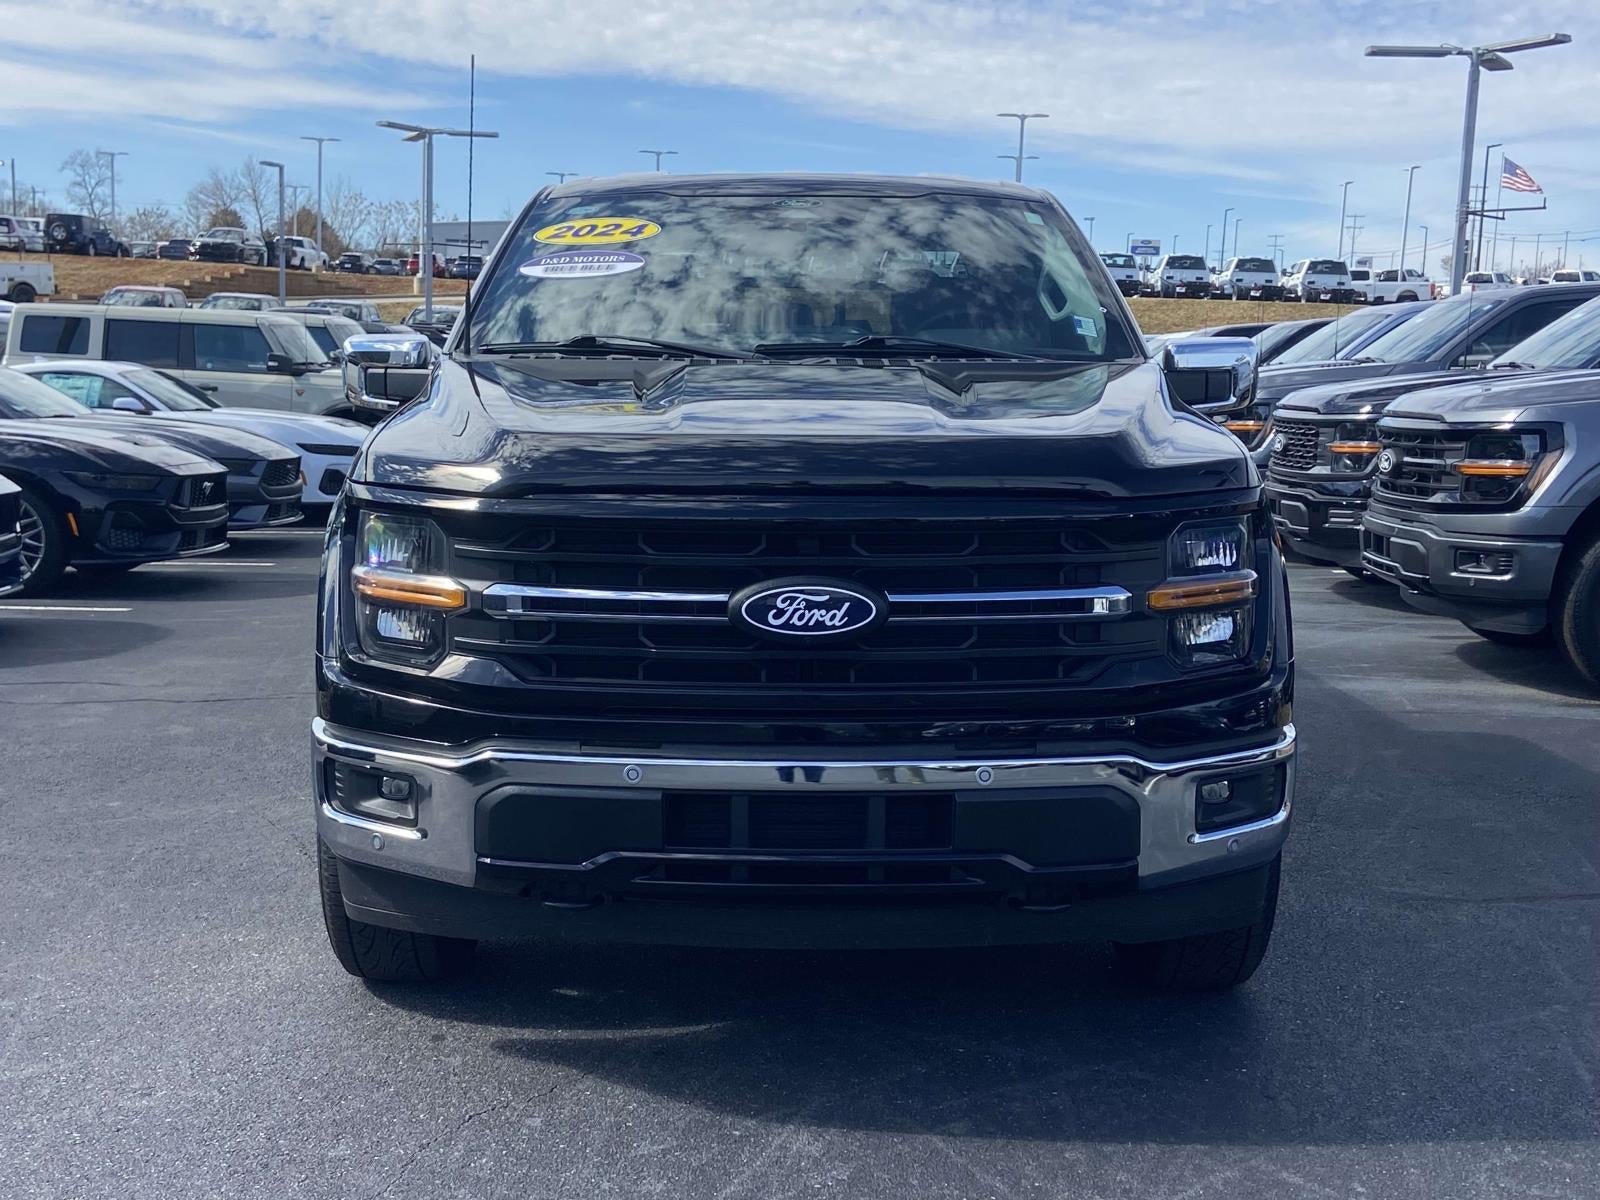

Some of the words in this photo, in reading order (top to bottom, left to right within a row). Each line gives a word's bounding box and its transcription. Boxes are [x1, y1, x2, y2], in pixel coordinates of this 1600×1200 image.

[545, 223, 649, 239] 2024
[540, 257, 569, 265] D&D
[572, 255, 625, 263] MOTORS
[768, 593, 850, 626] Ford
